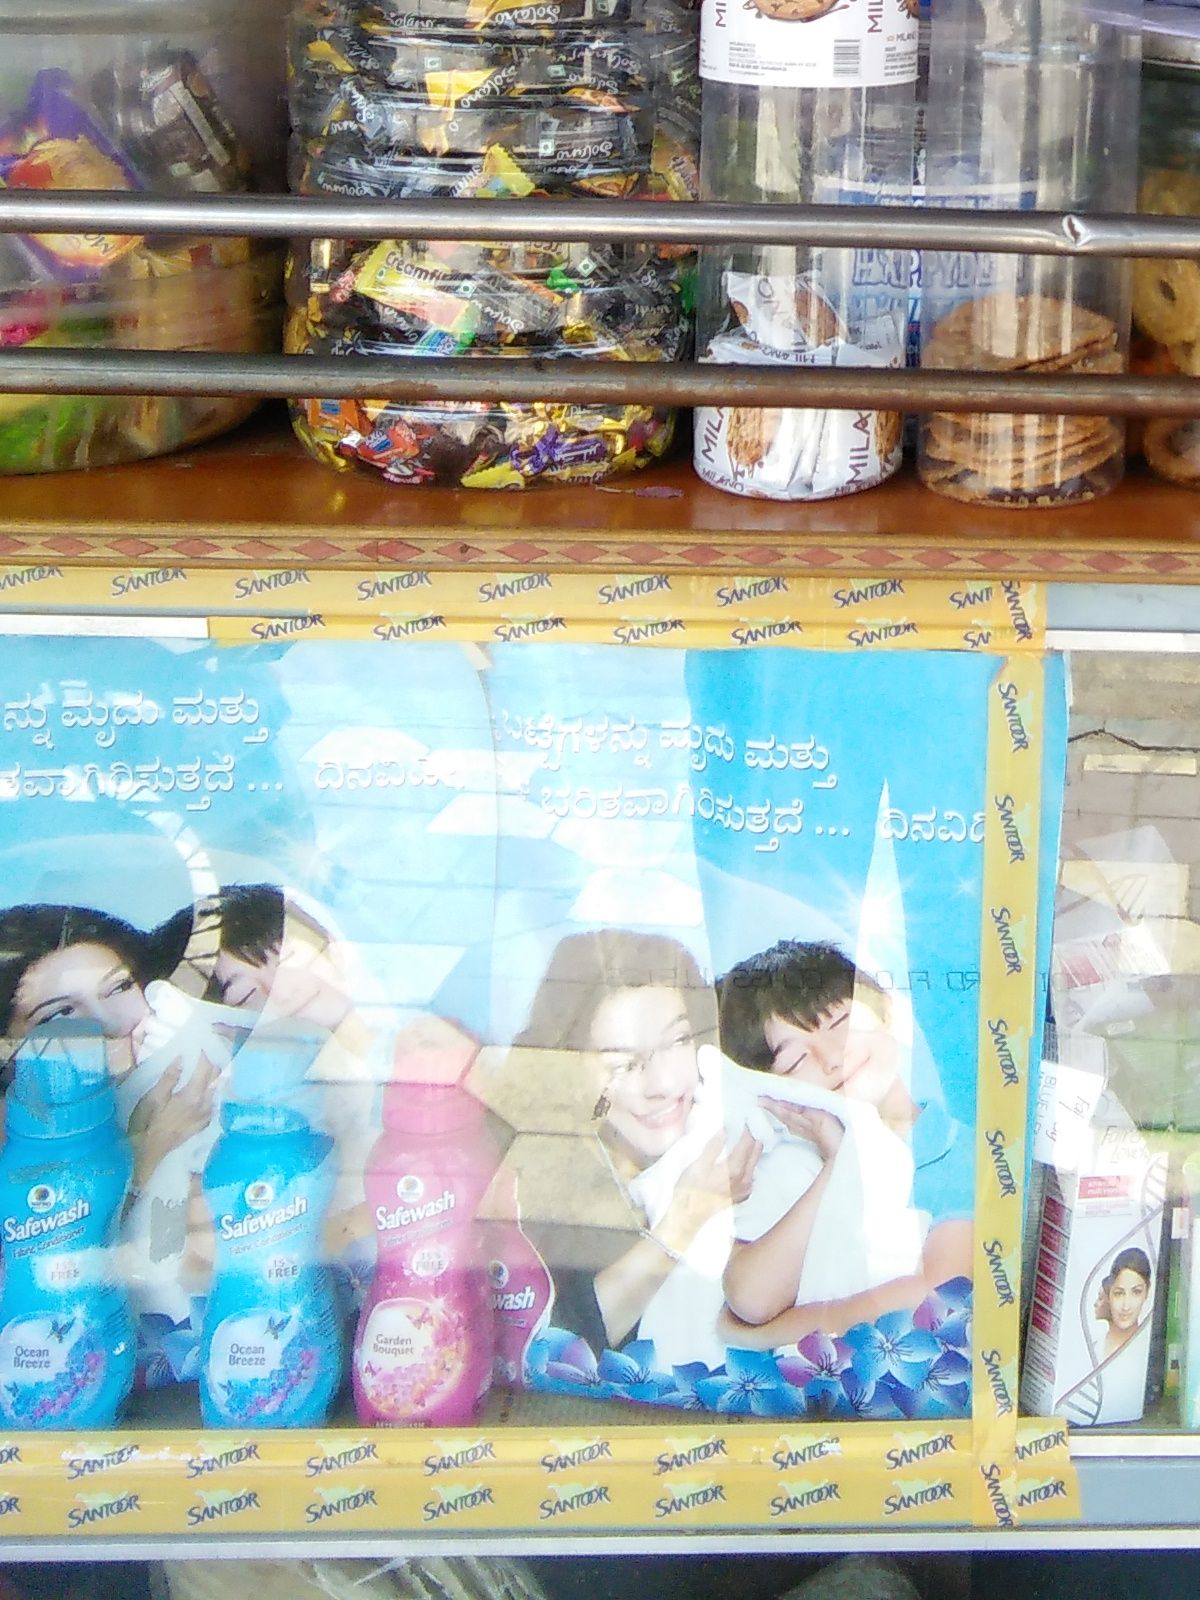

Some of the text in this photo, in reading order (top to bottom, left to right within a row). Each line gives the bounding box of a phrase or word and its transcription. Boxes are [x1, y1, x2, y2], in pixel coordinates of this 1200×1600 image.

[493, 2, 561, 25] Solano
[554, 141, 612, 160] Solano
[111, 567, 187, 596] SANTOOR
[235, 567, 311, 598] SANTOOR
[357, 570, 432, 601] SANTOOR
[479, 571, 552, 602] SANTOOR
[599, 574, 672, 605] SANTOOR
[716, 576, 789, 607] SANTOOR
[834, 578, 904, 609] SANTOOR
[1001, 579, 1033, 642] SANTOOR
[251, 614, 325, 640] SANTOOR
[373, 614, 446, 641] SANTOOR
[493, 616, 567, 643] SANTOOR
[731, 619, 803, 645] SANTOOR
[848, 621, 918, 647] SANTOOR
[173, 688, 269, 745] ಮತ್ತು
[999, 681, 1030, 753] SANTOOR
[744, 734, 838, 790] ಮತ್ತು
[995, 794, 1025, 864] SANTOOR
[988, 1018, 1019, 1088] SANTOOR
[4, 1198, 91, 1245] Safewash
[220, 1196, 308, 1244] Safewash
[377, 1190, 456, 1233] Safewash
[267, 1265, 299, 1281] FREE
[490, 1286, 536, 1312] wash
[14, 1344, 50, 1358] Ocean
[229, 1342, 266, 1357] Ocean
[372, 1343, 415, 1357] Bouquet
[375, 1334, 413, 1348] Garden
[12, 1356, 51, 1370] Breeze
[227, 1353, 267, 1368] Breeze
[980, 1349, 1012, 1418] SANTOOR
[186, 1442, 261, 1479] SANTOOR
[423, 1440, 496, 1477] SANTOOR
[653, 1437, 729, 1476] SANTOOR
[885, 1433, 956, 1471] SANTOOR
[305, 1488, 379, 1525] SANTOOR
[538, 1485, 612, 1520] SANTOOR
[654, 1483, 728, 1519] SANTOOR
[769, 1481, 843, 1517] SANTOOR
[883, 1480, 955, 1516] SANTOOR
[980, 1463, 1013, 1528] SANTOOR
[68, 1494, 142, 1530] SANTOOR
